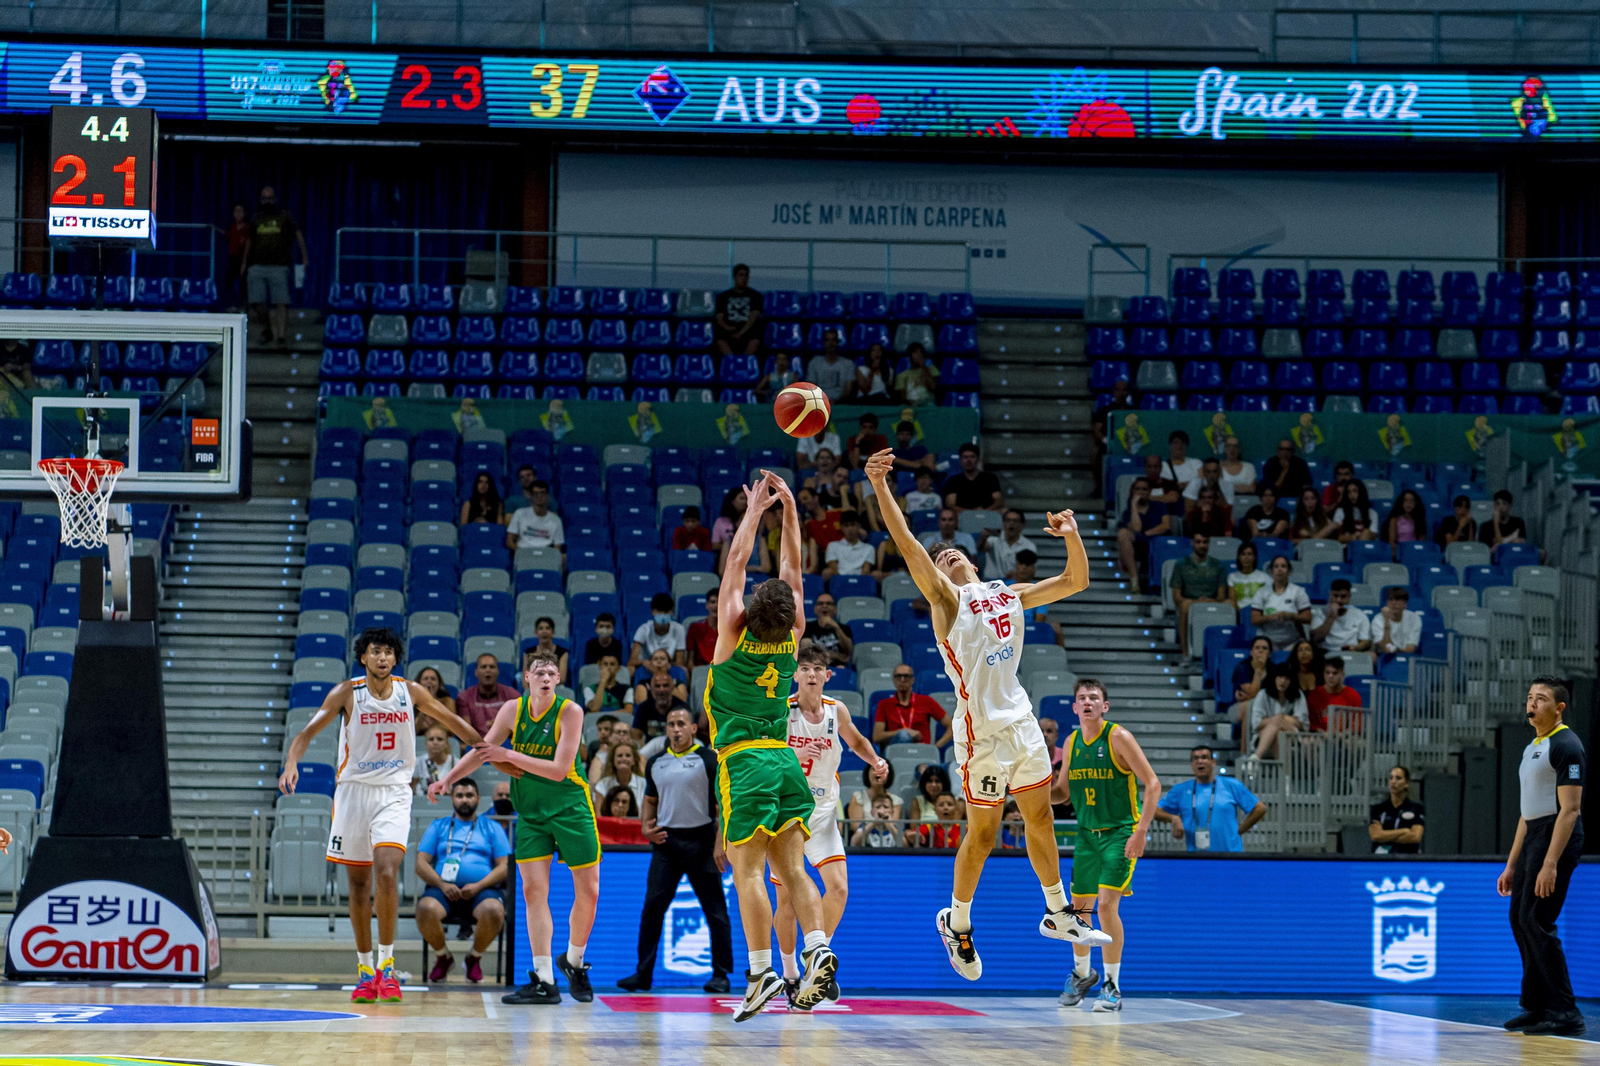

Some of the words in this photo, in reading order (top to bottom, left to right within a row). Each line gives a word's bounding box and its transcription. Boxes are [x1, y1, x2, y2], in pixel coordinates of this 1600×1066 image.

[49, 51, 147, 107] 4.6
[401, 64, 482, 111] 2.3
[529, 62, 600, 119] 37
[712, 77, 822, 125] AUS
[1179, 67, 1324, 140] Spain
[1341, 80, 1422, 121] 202
[81, 116, 129, 142] 4.4
[51, 155, 136, 206] 2.1
[79, 216, 146, 229] TISSOT
[772, 201, 811, 225] JOSÉ
[849, 202, 918, 227] MARTÍN
[924, 206, 1007, 228] CARPENA
[195, 453, 214, 463] FIBA
[989, 613, 1011, 640] 16
[755, 662, 779, 698] 4
[360, 710, 410, 725] ESPAÑA
[375, 732, 396, 751] 13
[1068, 768, 1114, 781] AUSTRALIA
[1084, 788, 1096, 806] 12
[47, 895, 161, 926] 百岁山
[21, 925, 200, 972] Ganten
